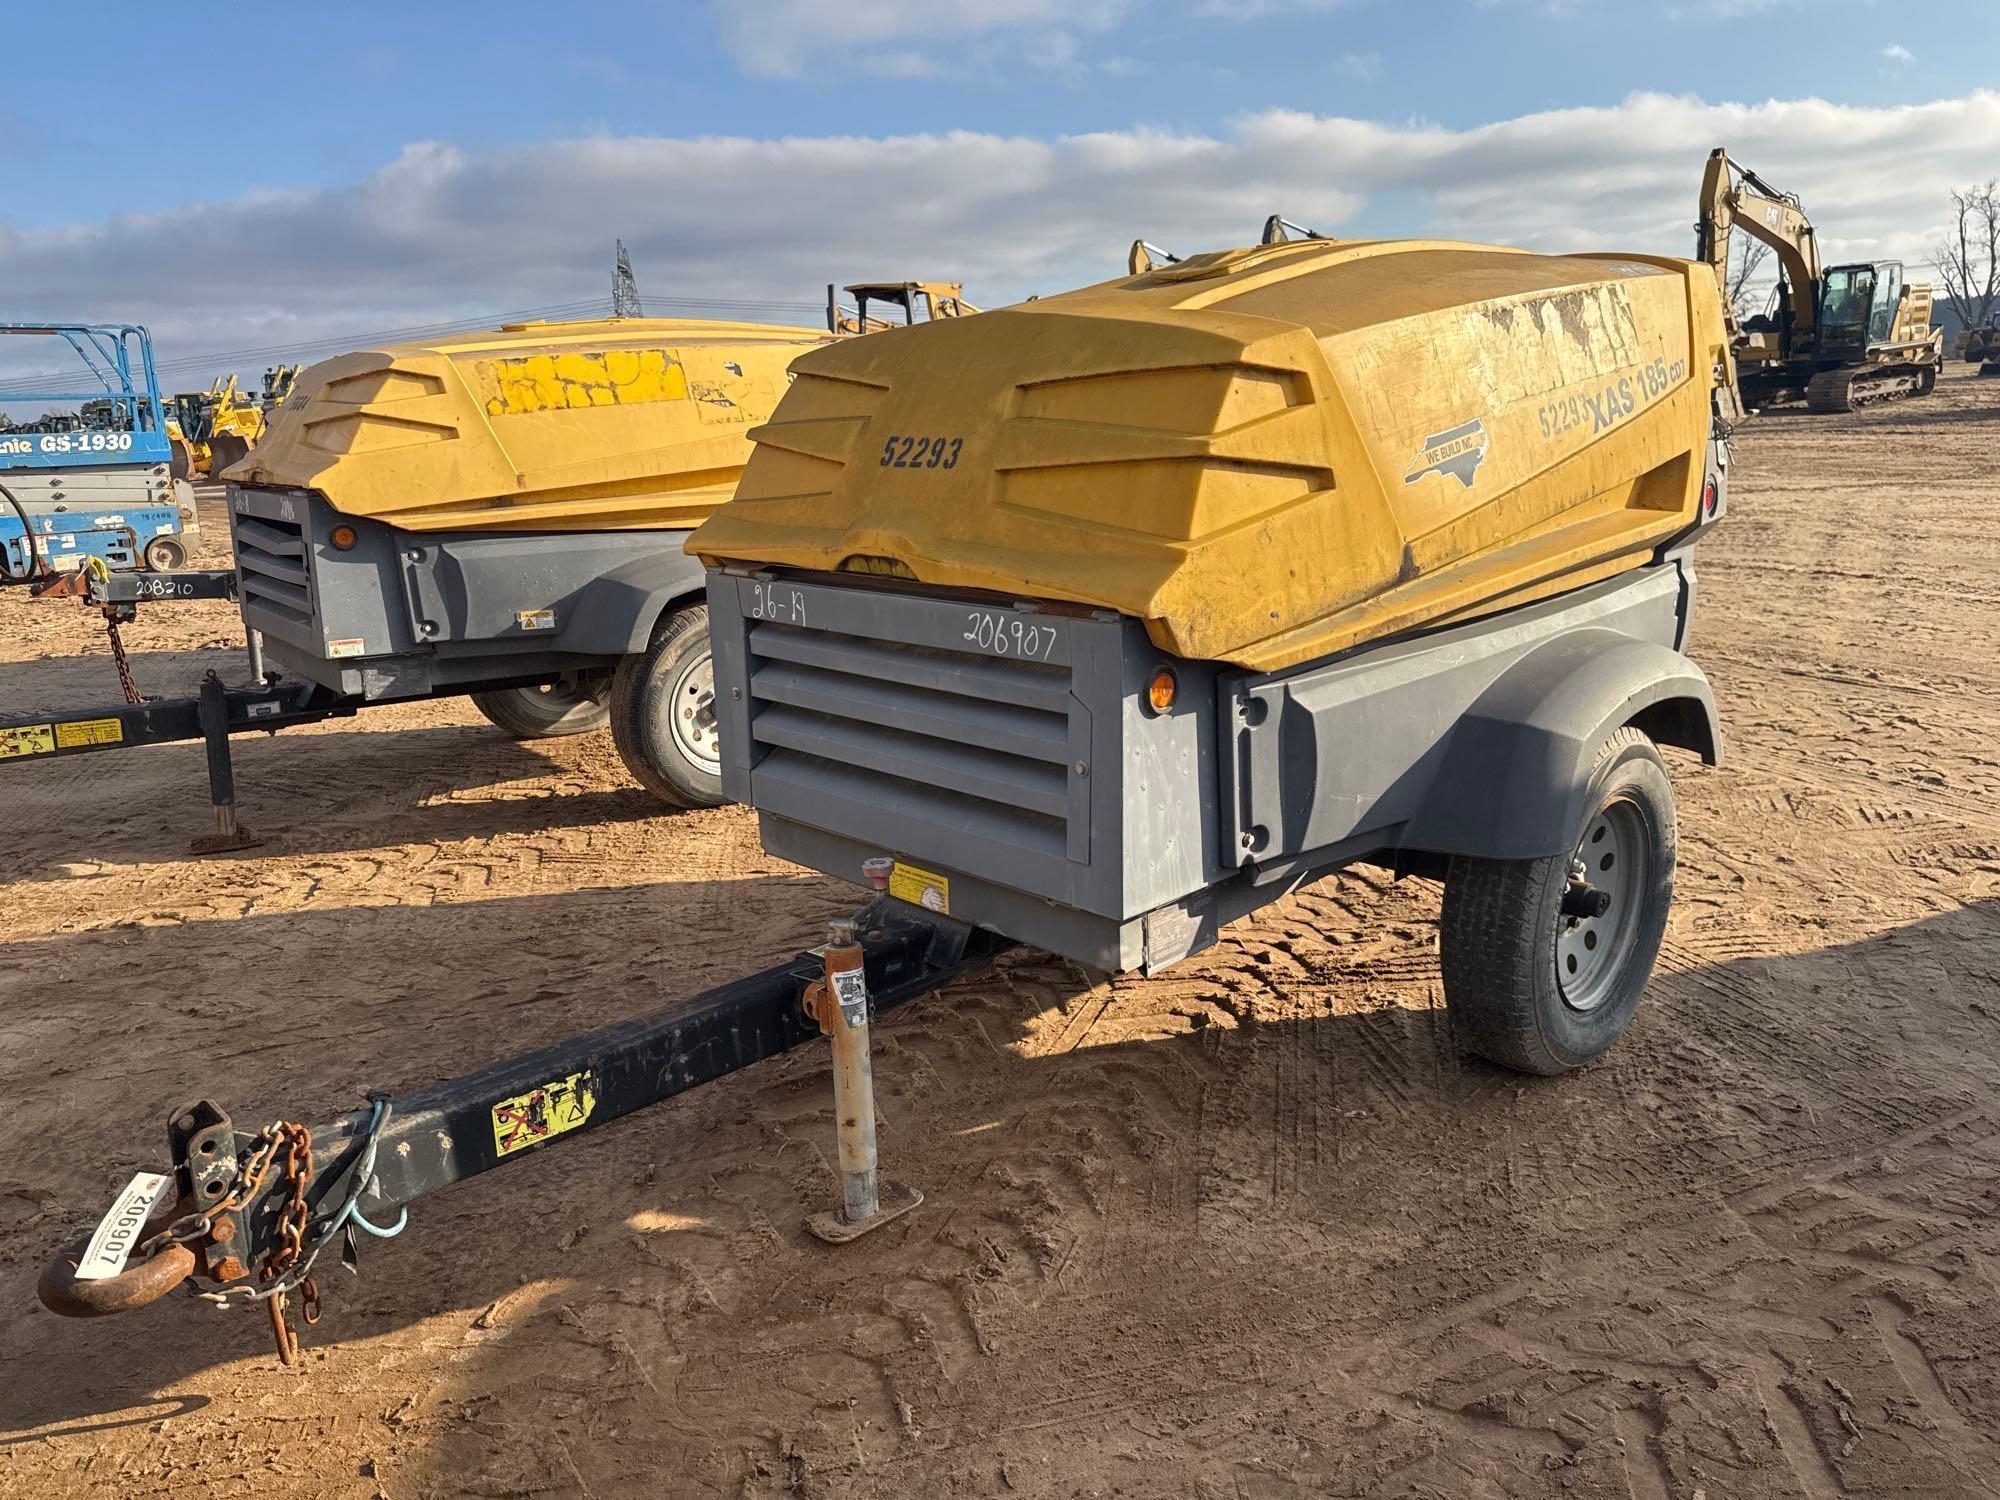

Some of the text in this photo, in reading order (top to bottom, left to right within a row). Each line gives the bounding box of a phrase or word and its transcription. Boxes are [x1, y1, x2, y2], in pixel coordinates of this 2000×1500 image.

[1538, 391, 1589, 438] 52293
[1587, 376, 1635, 434] XAS
[1636, 356, 1668, 401] 185
[40, 433, 132, 452] GS-1930
[880, 436, 963, 469] 52293
[1425, 436, 1473, 465] WE BUILD NC
[136, 579, 193, 596] 208210
[963, 612, 1057, 661] 206907
[100, 1195, 154, 1265] 206907
